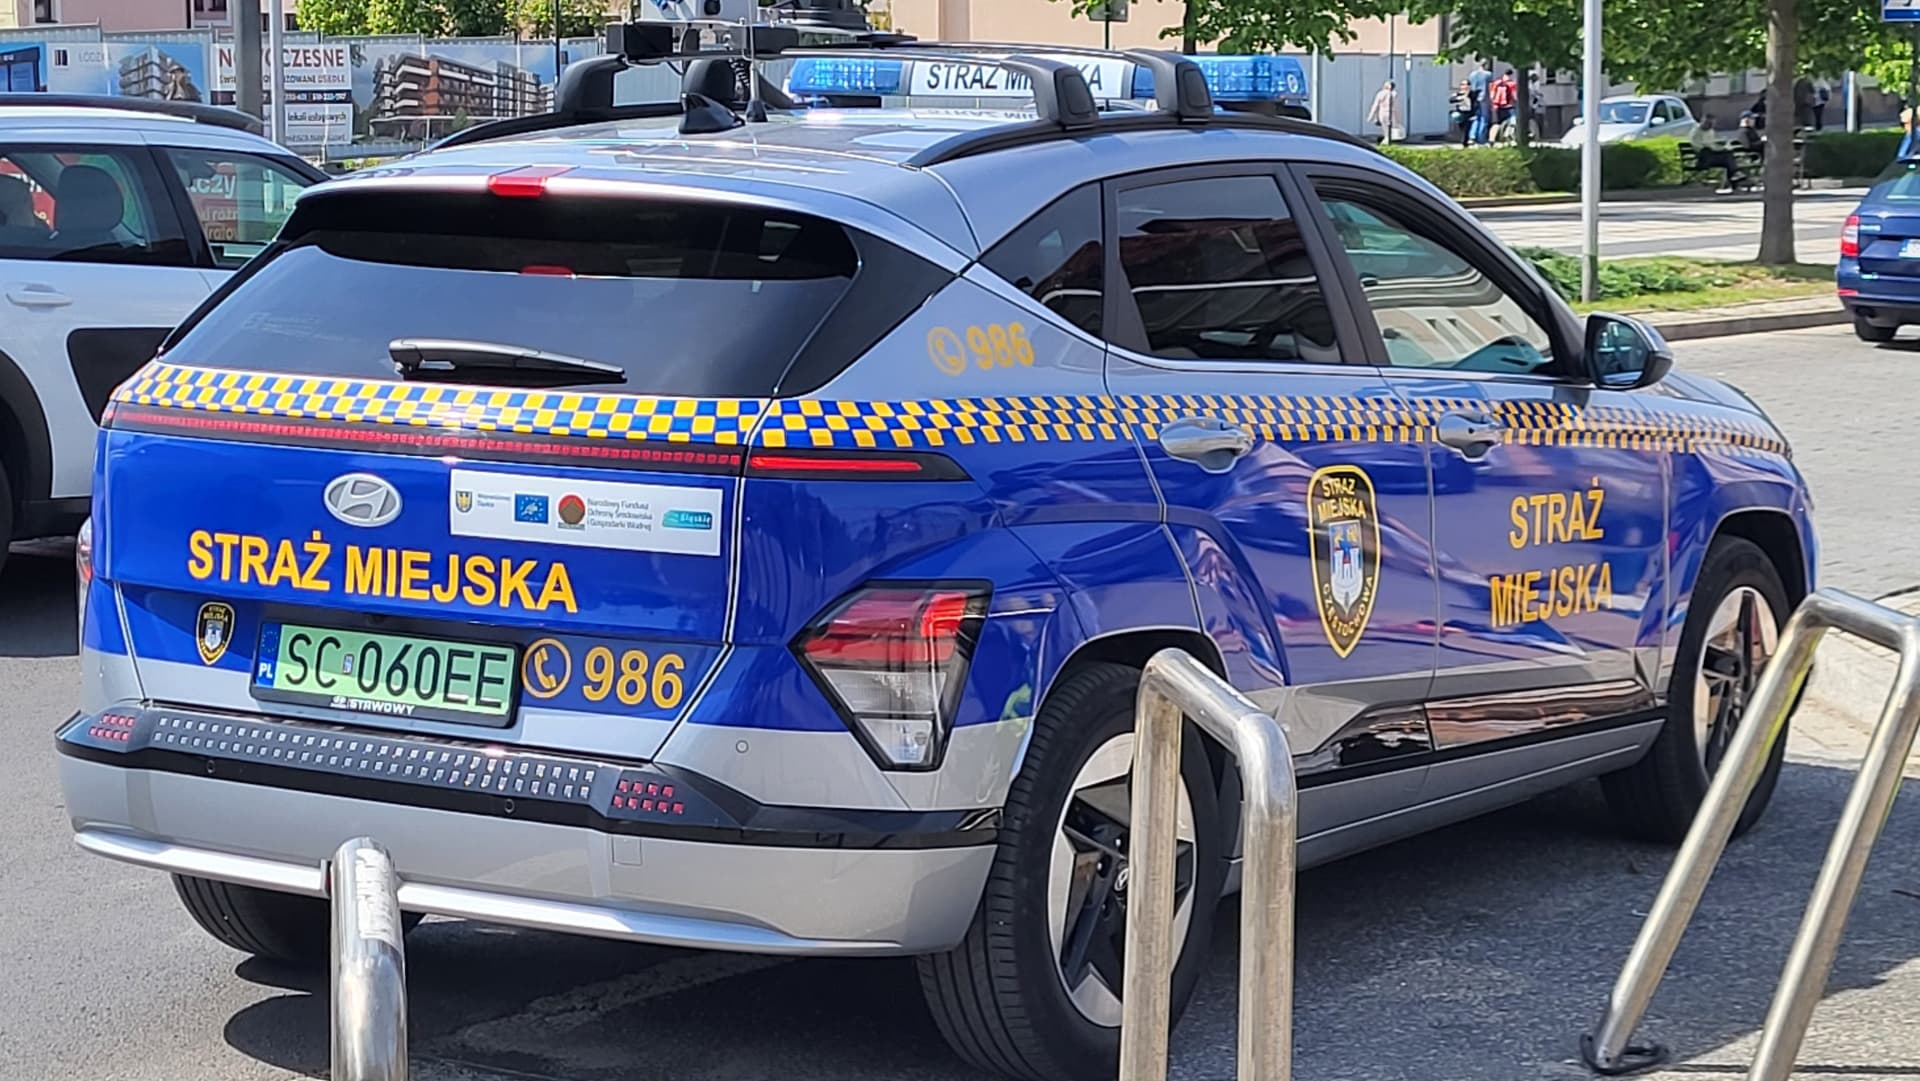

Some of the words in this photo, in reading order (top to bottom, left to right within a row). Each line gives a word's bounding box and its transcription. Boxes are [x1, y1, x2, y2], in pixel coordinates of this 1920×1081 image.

[966, 322, 1035, 370] 986
[1317, 497, 1367, 522] MIEJSKA
[1509, 476, 1604, 549] STRAŻ
[187, 530, 331, 592] STRAŻ
[344, 545, 579, 614] MIEJSKA
[1489, 562, 1614, 628] MIEJSKA
[258, 662, 274, 680] PL
[284, 632, 343, 689] SC
[356, 640, 509, 710] 060EE
[582, 645, 686, 710] 986
